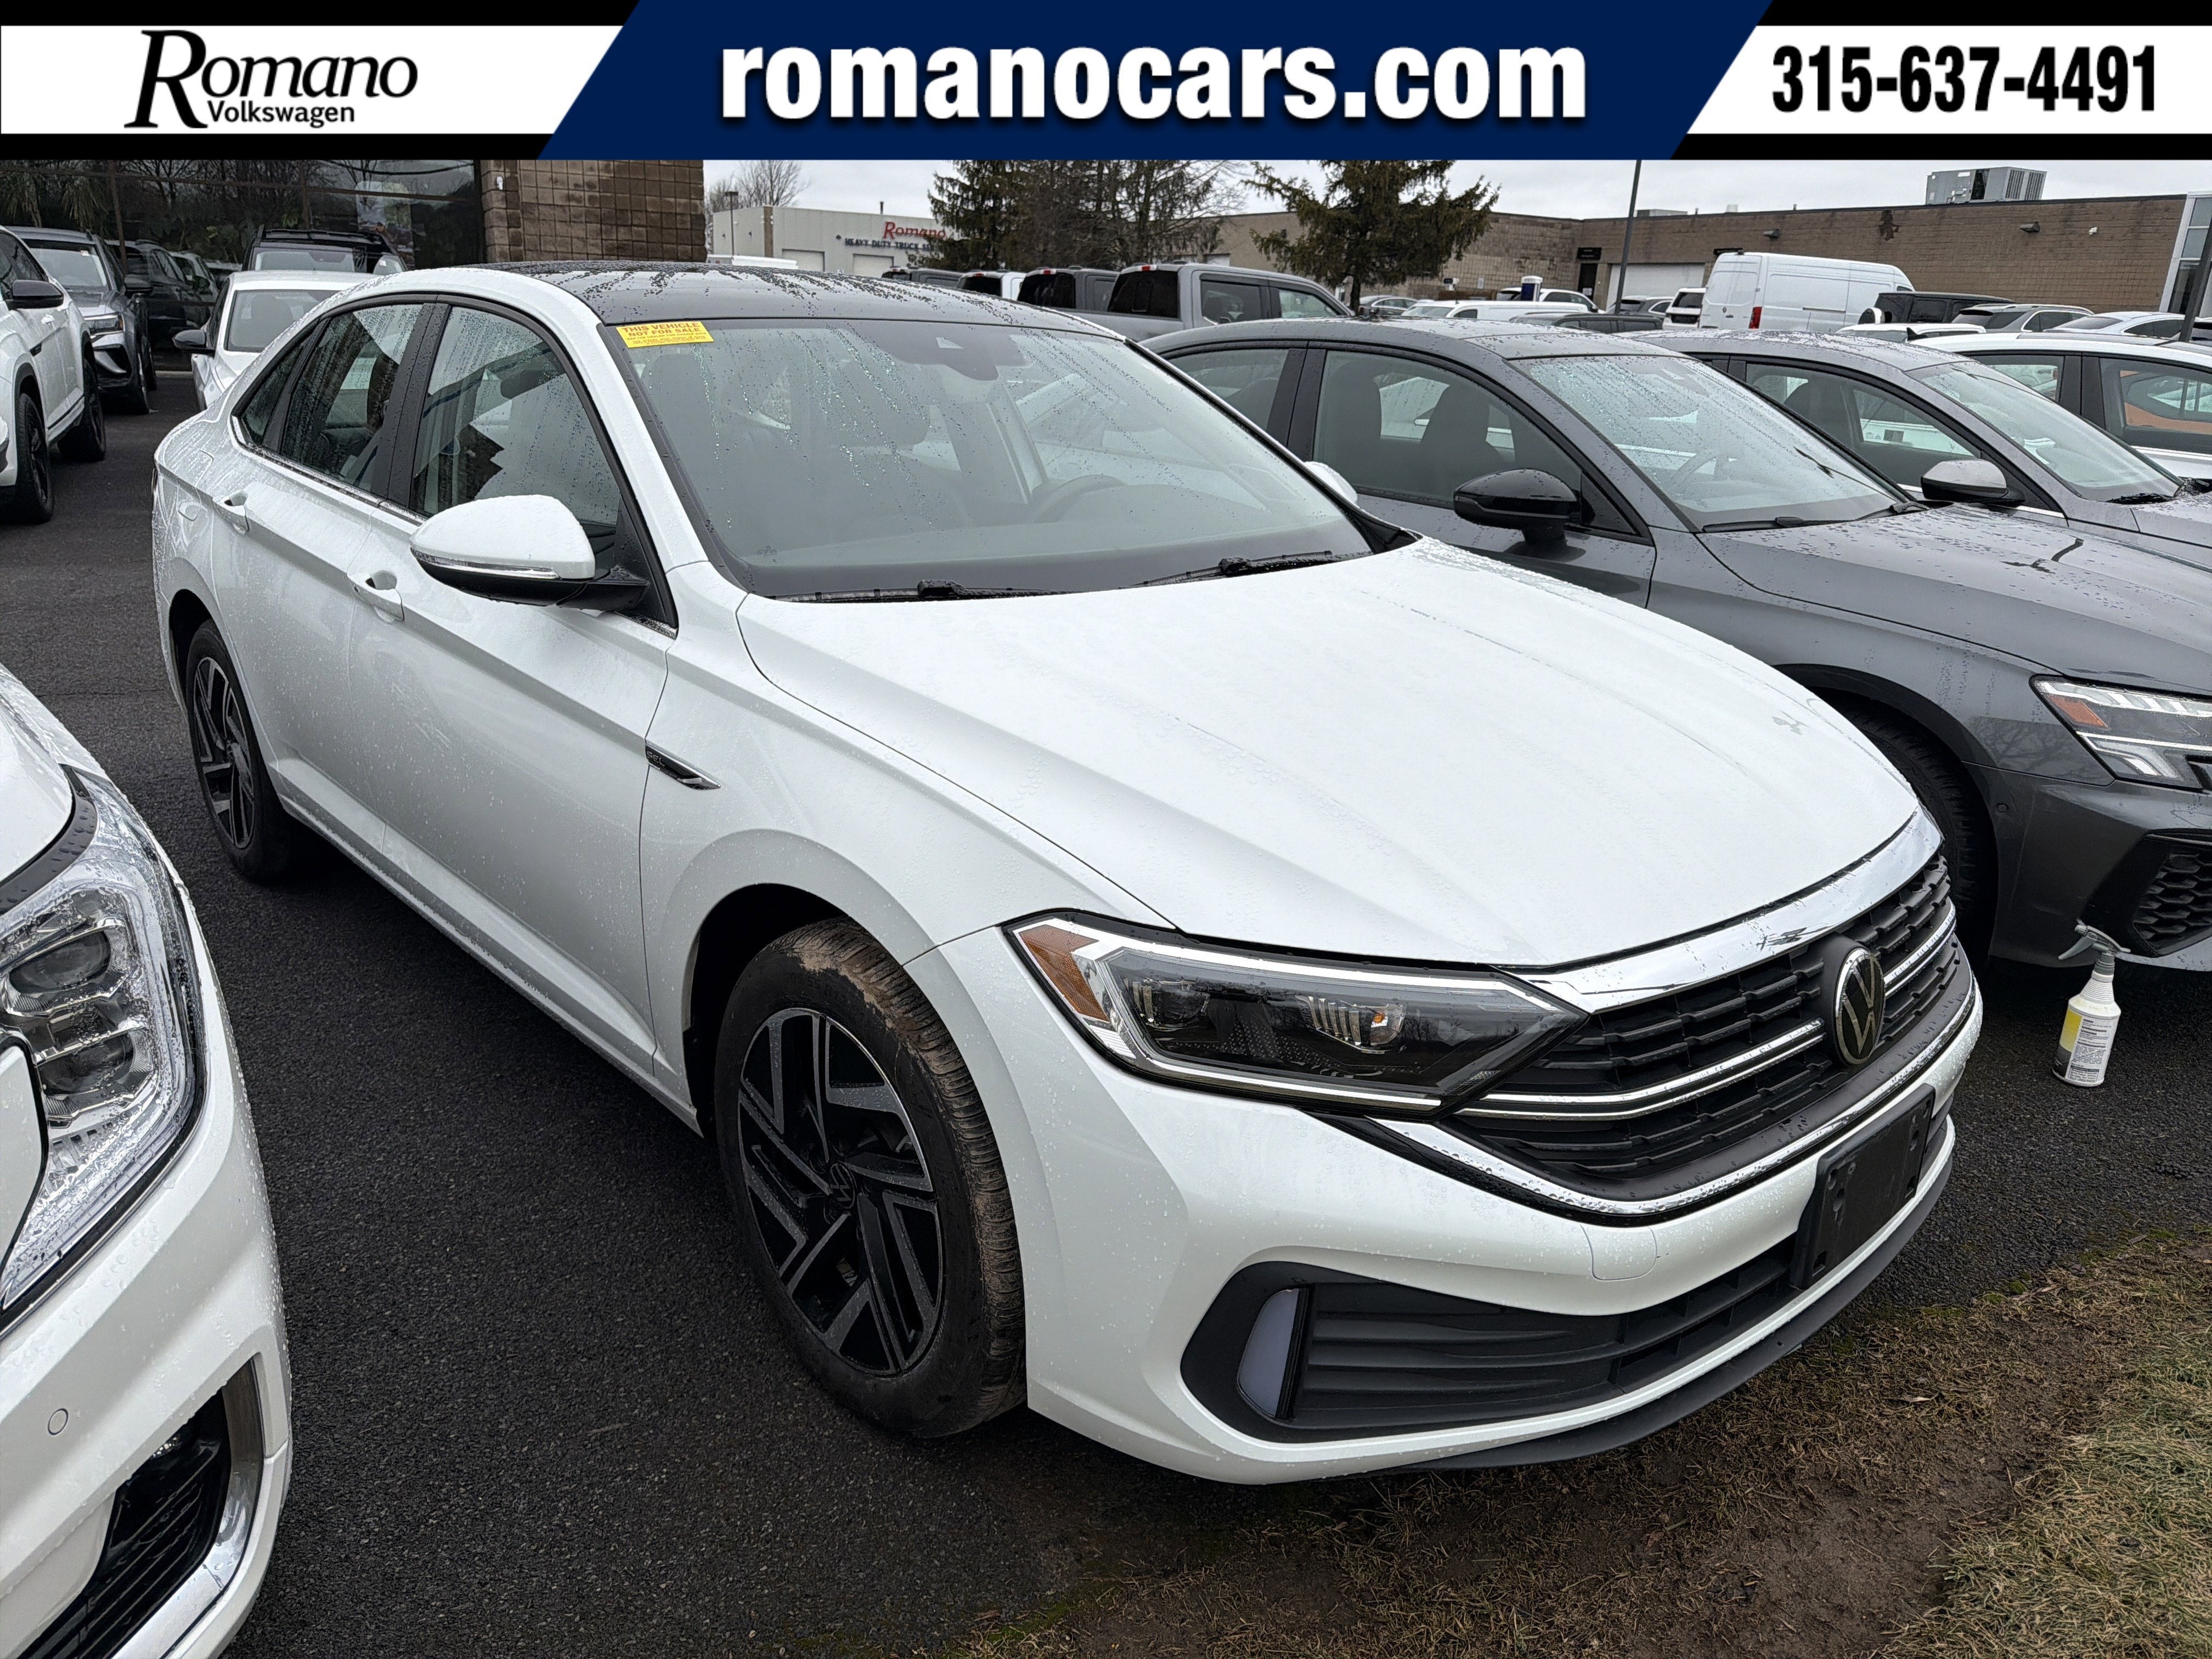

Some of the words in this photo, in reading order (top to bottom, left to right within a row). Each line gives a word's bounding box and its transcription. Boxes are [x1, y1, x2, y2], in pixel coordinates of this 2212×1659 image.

[882, 221, 946, 240] Romano
[844, 238, 870, 246] HEAVY
[894, 241, 919, 249] TRUCK
[646, 751, 665, 767] SEL
